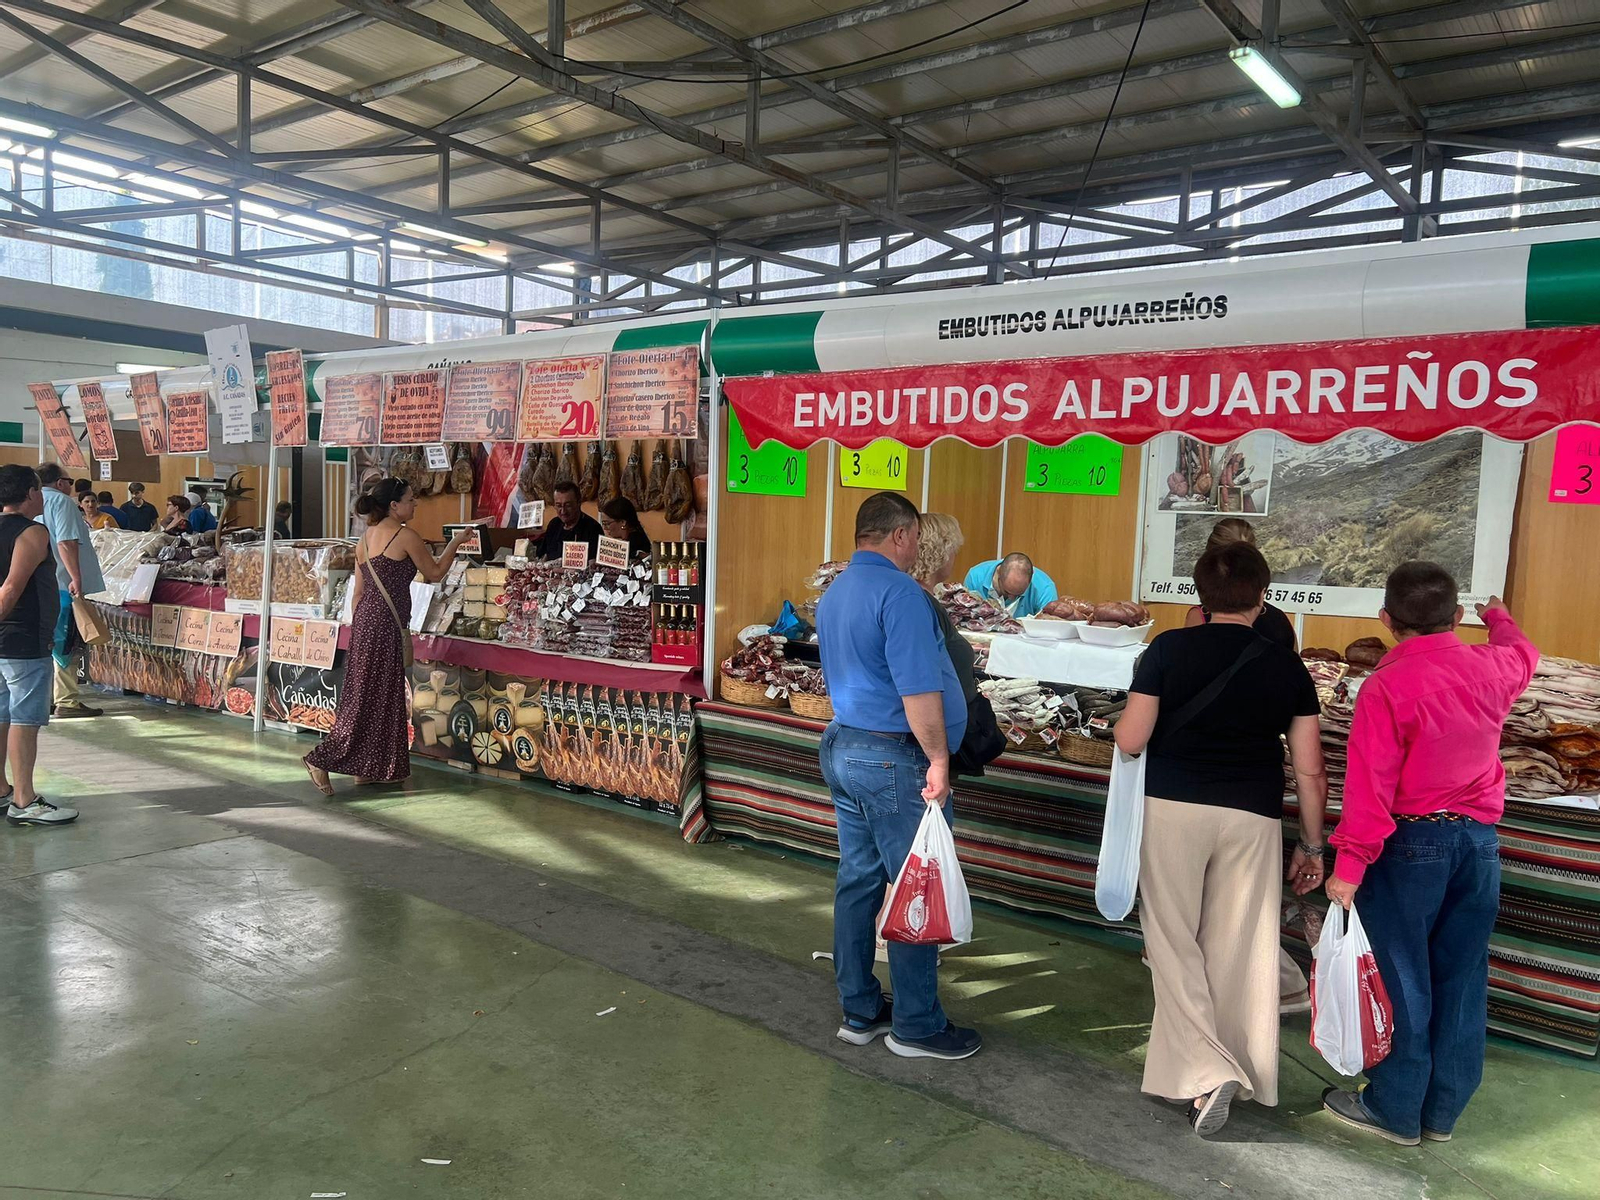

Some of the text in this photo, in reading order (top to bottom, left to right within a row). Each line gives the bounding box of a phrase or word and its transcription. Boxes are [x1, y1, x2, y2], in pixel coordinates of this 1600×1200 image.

[938, 292, 1228, 340] EMBUTIDOS ALPUJARREÑOS
[550, 363, 578, 373] Oferta
[793, 351, 1538, 428] EMBUTIDOS ALPUJARREÑOS
[149, 428, 164, 450] 20
[739, 454, 749, 484] 3
[782, 456, 798, 486] 10
[852, 452, 861, 476] 3
[886, 453, 901, 478] 10
[1037, 463, 1049, 487] 3
[1088, 465, 1106, 487] 10
[1574, 464, 1593, 495] 3
[1150, 581, 1173, 594] Telf.
[1177, 583, 1196, 595] 950
[1275, 590, 1288, 602] 57
[1291, 591, 1305, 603] 45
[1309, 592, 1323, 604] 65
[185, 617, 204, 630] Cecina
[215, 621, 234, 634] Cecina
[276, 627, 299, 643] Cecina
[310, 630, 329, 644] Cecina
[282, 684, 337, 710] Cañadas
